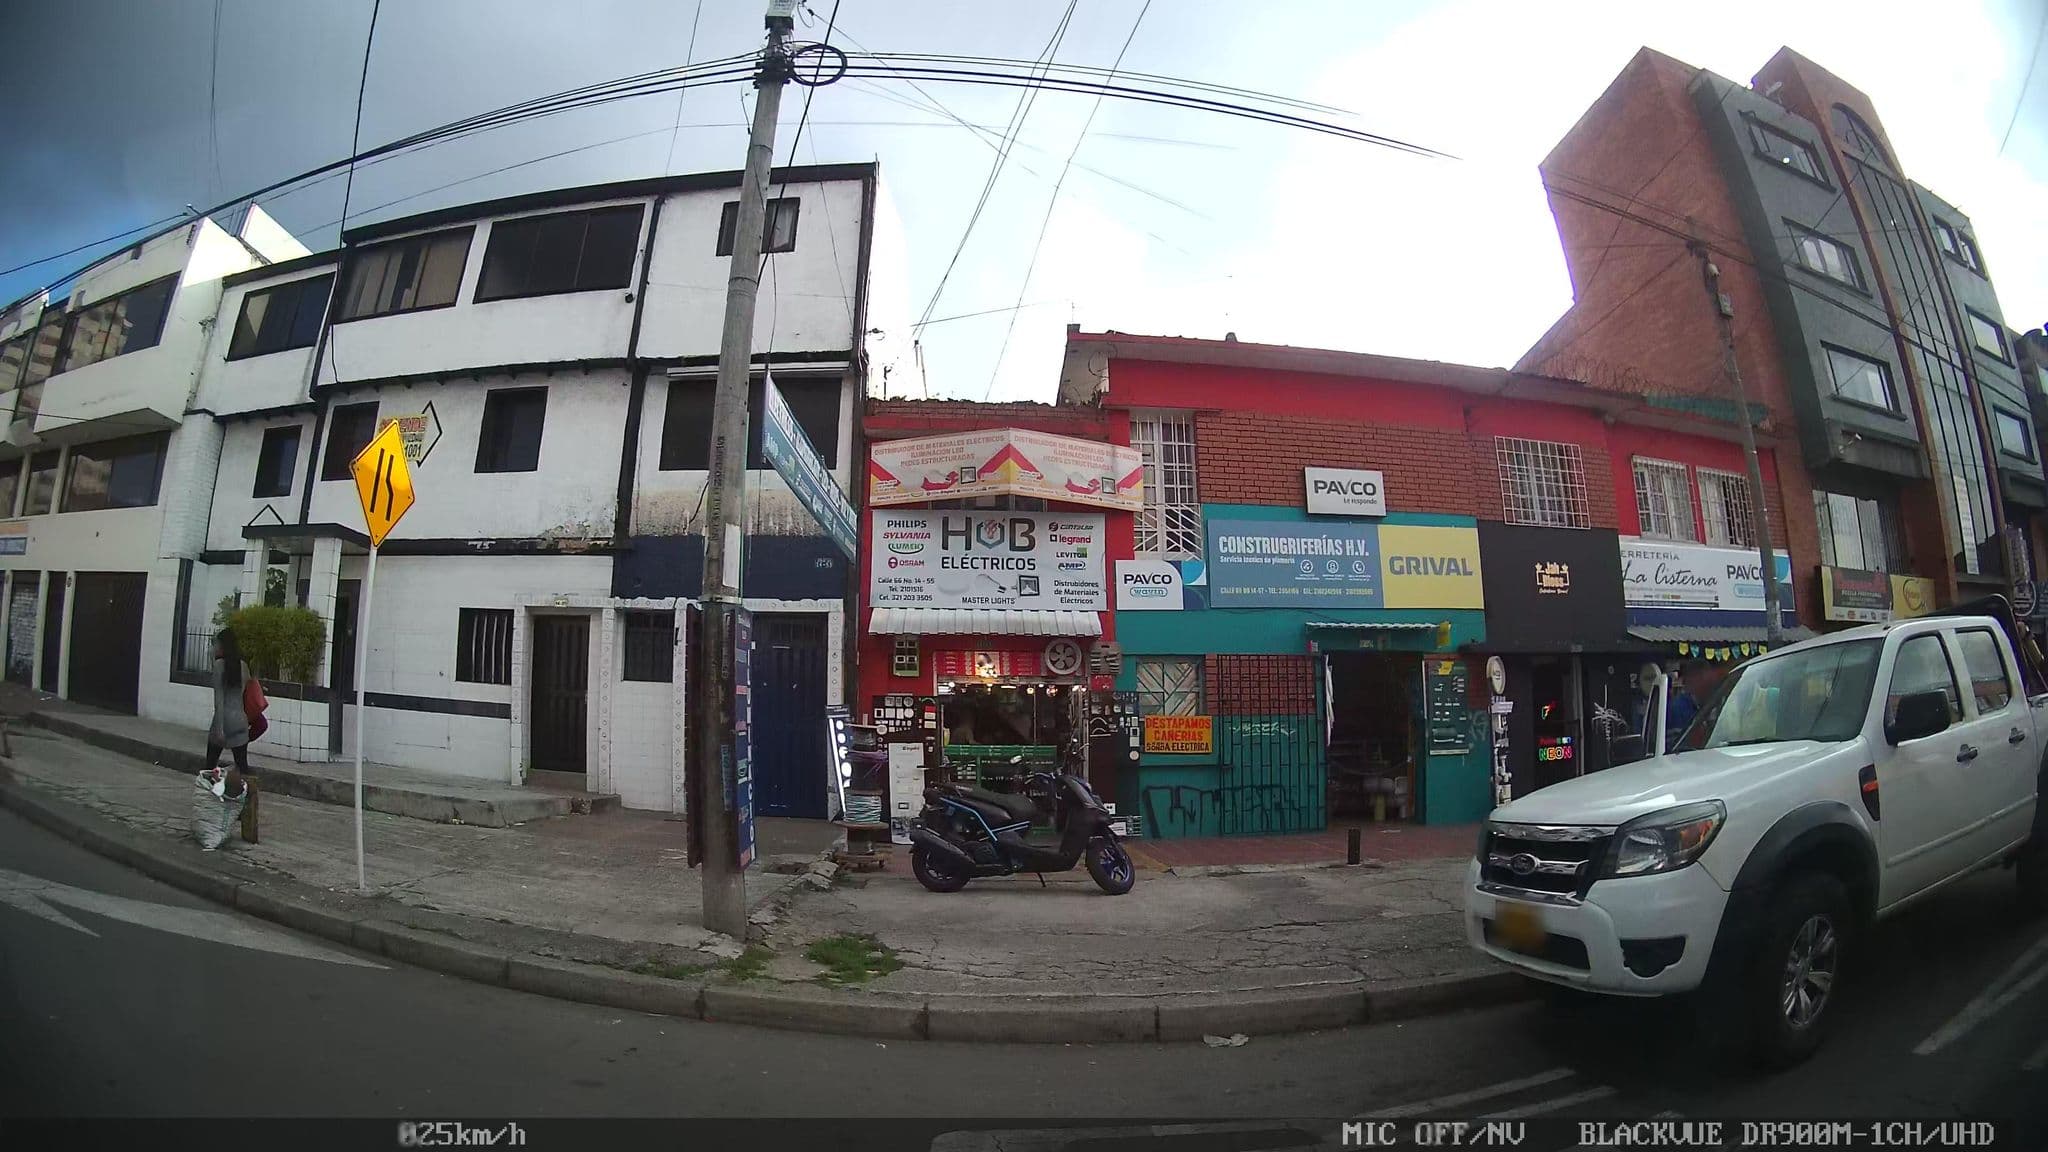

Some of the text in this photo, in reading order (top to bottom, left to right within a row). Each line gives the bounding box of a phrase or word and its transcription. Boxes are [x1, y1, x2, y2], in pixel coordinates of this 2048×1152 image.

[1314, 478, 1377, 496] PAVCO
[887, 520, 927, 528] PHILIPS
[883, 532, 931, 540] SYLVANIA
[1059, 534, 1091, 545] legrand
[1219, 534, 1370, 557] CONSTRUGRIFERÍAS H.V.
[941, 553, 1036, 570] ELÉCTRICOS
[1389, 556, 1473, 576] GRIVAL
[1124, 572, 1173, 584] PAVCO
[1623, 559, 1718, 586] La Cisterna
[990, 597, 1016, 605] LIGHTS
[1146, 717, 1211, 729] DESTAPAMOS
[1172, 742, 1210, 751] ELECTRICA
[1539, 746, 1572, 761] NEON
